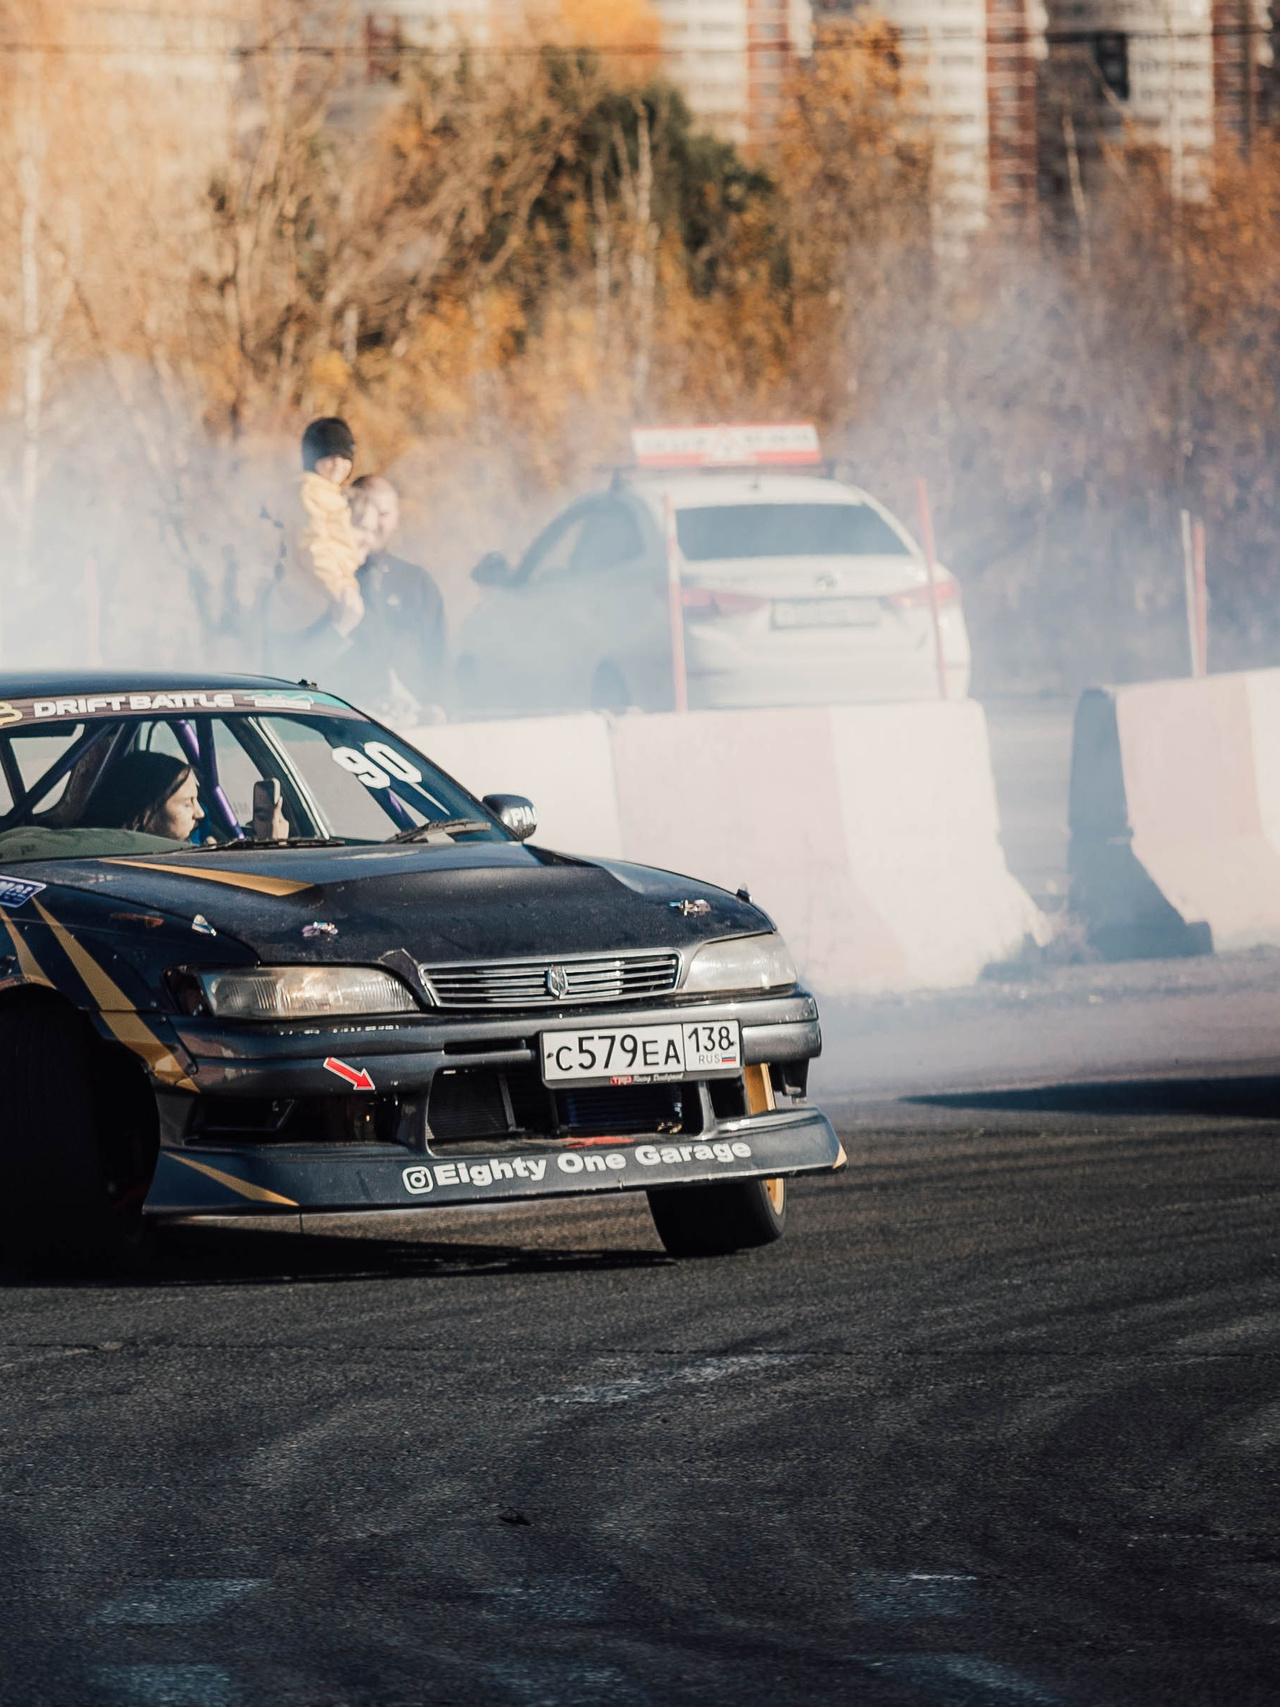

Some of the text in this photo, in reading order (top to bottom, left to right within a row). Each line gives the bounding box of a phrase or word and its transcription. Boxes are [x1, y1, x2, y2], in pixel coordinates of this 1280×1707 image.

[33, 696, 125, 717] DRIFT
[129, 694, 235, 710] BATTLE
[332, 741, 422, 789] 90
[556, 1026, 734, 1071] C579EA 138
[698, 1054, 720, 1065] RUS
[434, 1144, 752, 1186] Eighty One Garage
